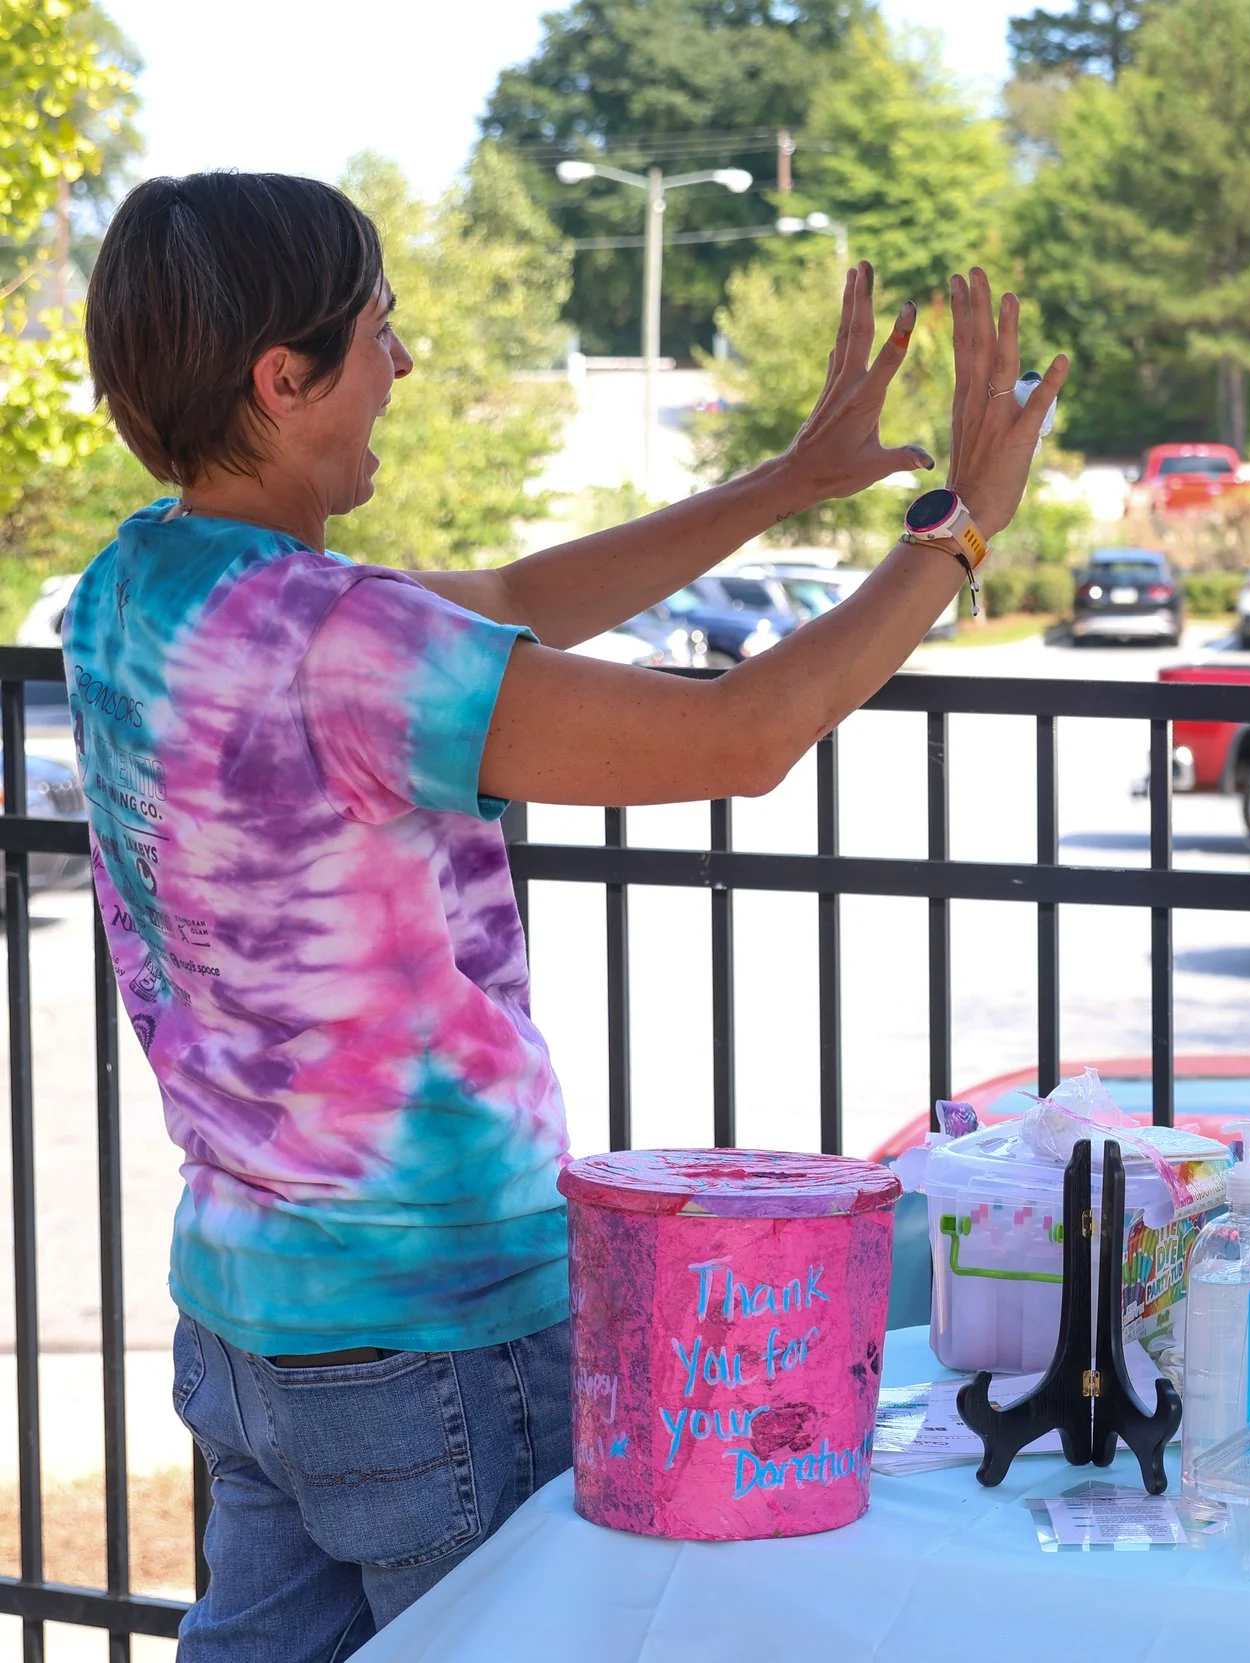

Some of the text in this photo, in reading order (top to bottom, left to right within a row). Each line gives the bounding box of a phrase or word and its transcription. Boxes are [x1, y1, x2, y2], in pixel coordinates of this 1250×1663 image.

[74, 664, 144, 728] SPONSORS
[140, 800, 163, 820] CO.
[123, 834, 159, 864] ZAXBYS
[197, 964, 221, 977] space
[1156, 1239, 1178, 1273] DYE
[688, 1254, 831, 1321] Thank
[1146, 1273, 1169, 1301] PARTY
[761, 1326, 821, 1382] for
[658, 1403, 771, 1470] your
